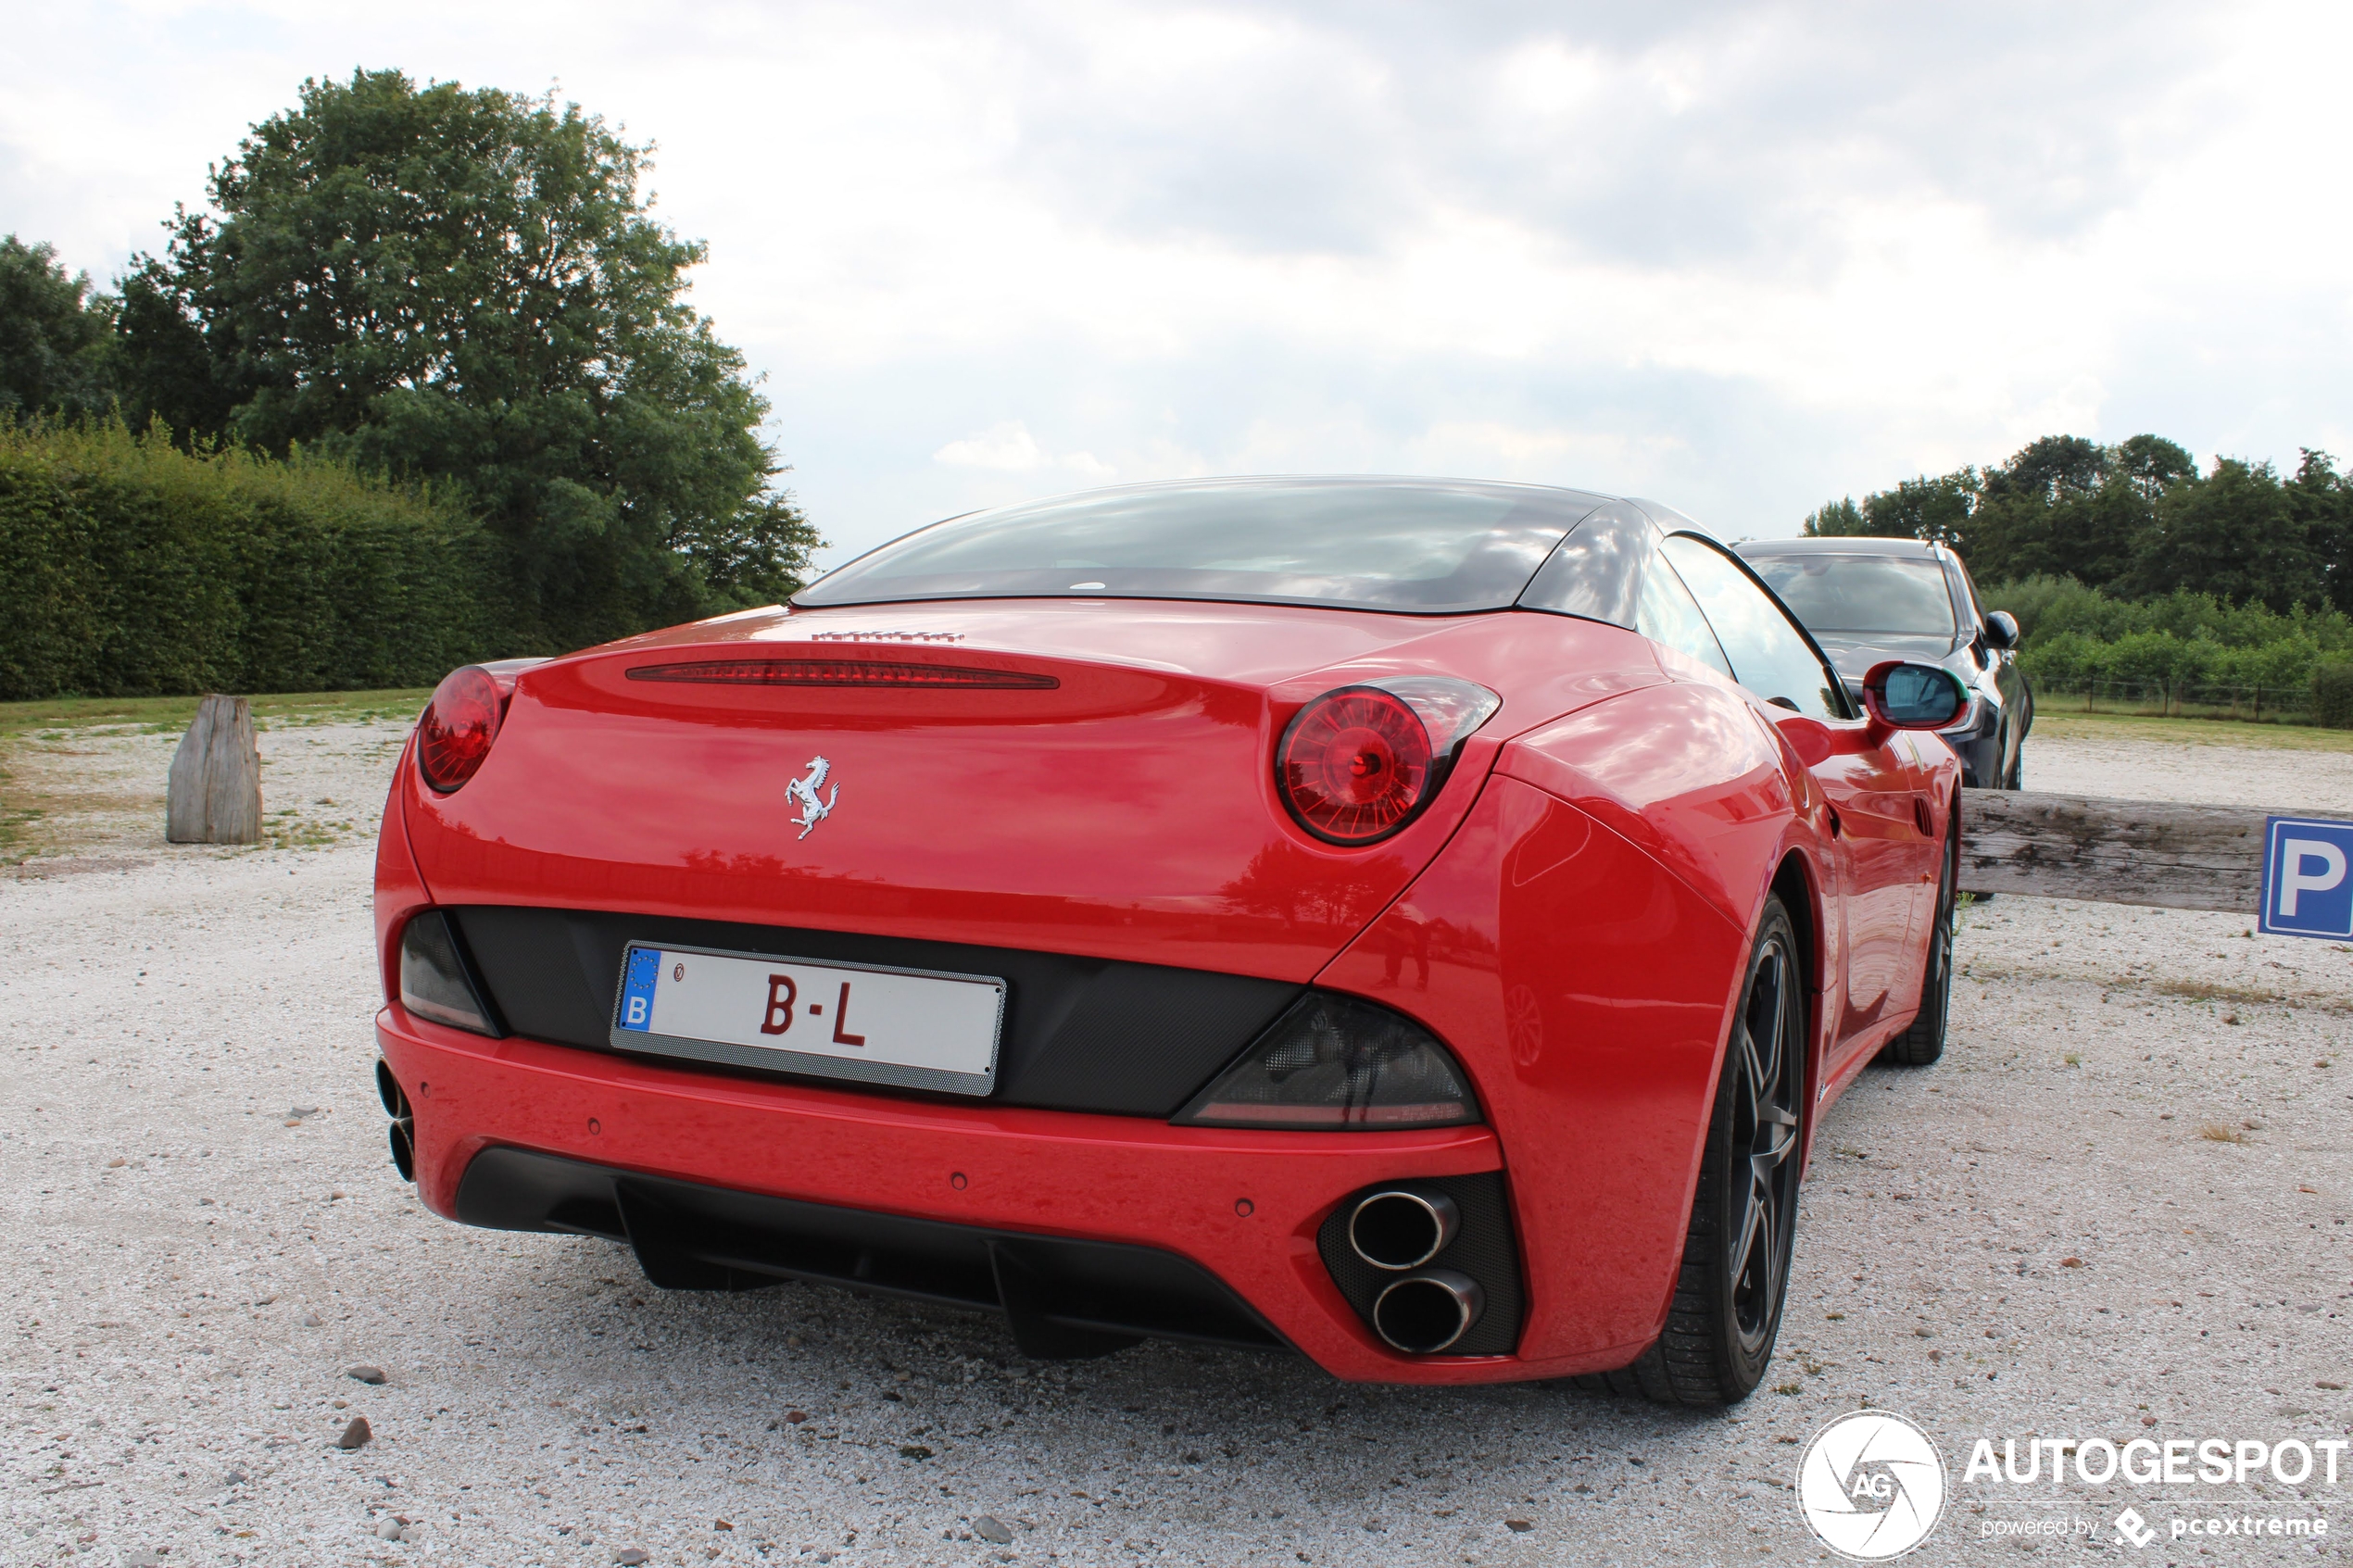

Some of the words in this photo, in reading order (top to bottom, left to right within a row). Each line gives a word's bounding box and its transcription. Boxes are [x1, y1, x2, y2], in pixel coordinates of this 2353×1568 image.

[2279, 838, 2347, 917] P
[627, 997, 648, 1024] B
[760, 973, 865, 1047] B-L
